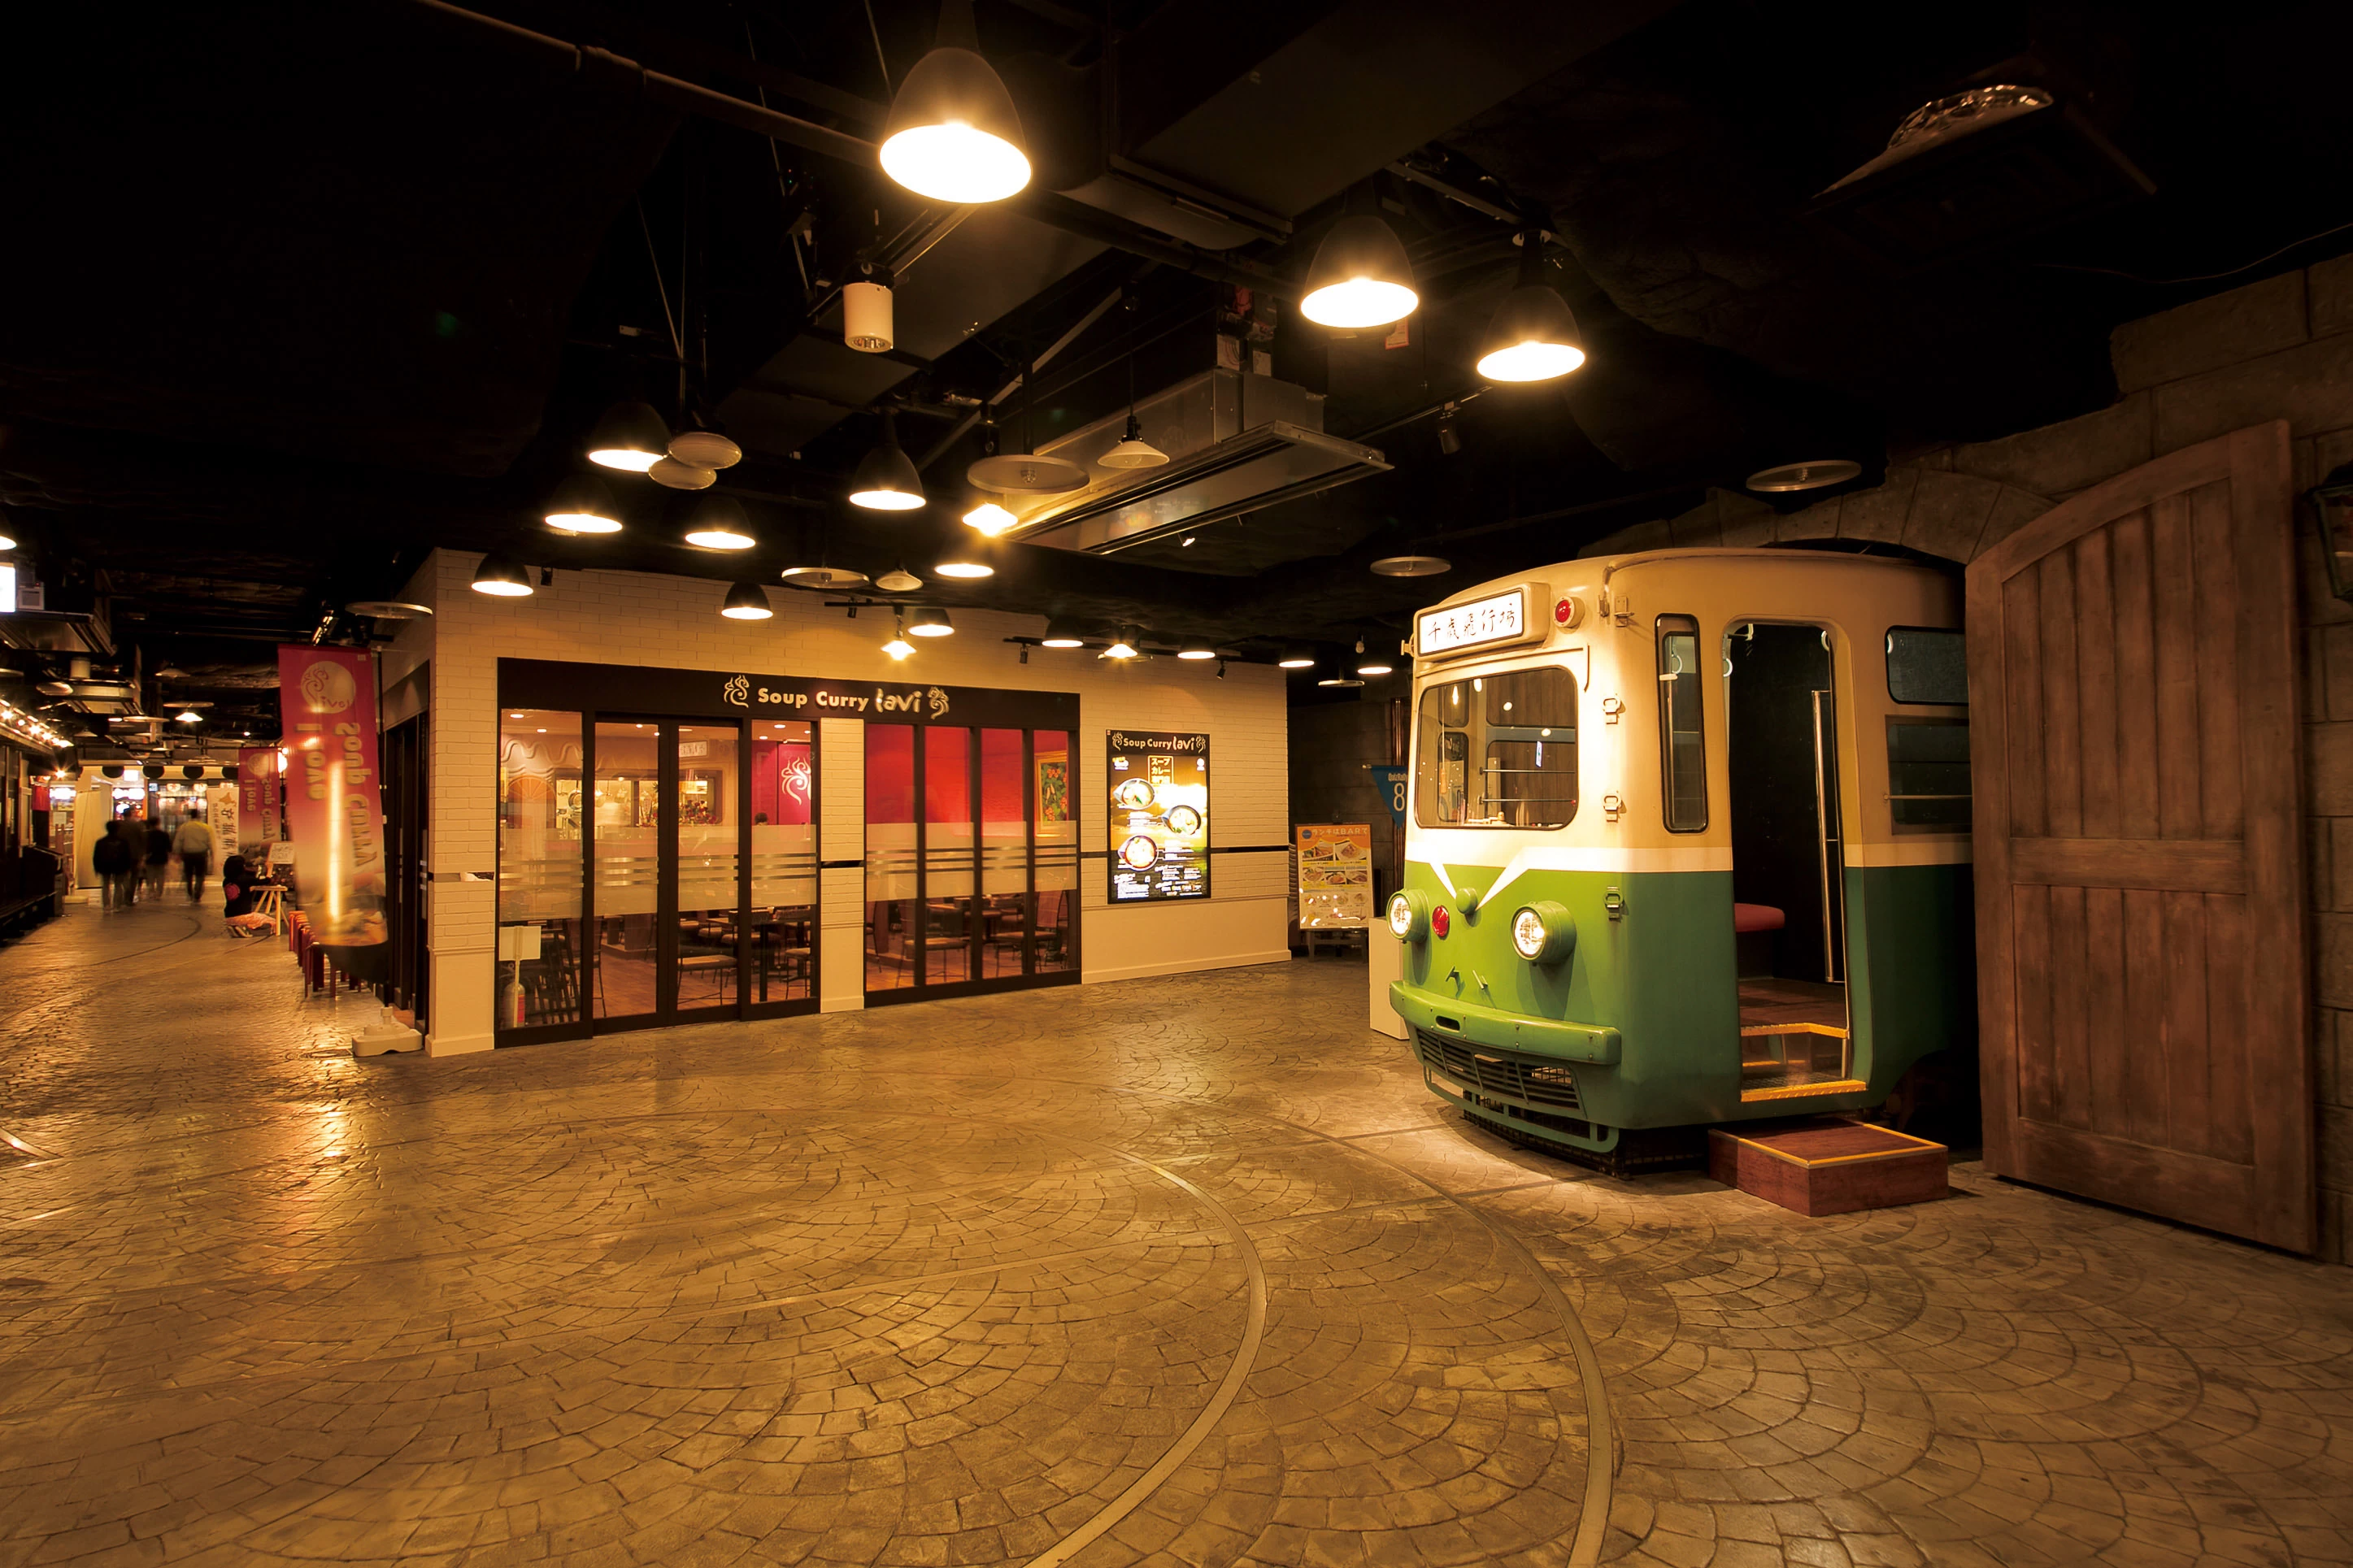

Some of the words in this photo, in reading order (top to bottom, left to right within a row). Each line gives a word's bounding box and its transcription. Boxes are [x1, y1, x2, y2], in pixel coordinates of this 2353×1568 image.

[1427, 602, 1516, 644] 千歳飛行場
[758, 688, 808, 709] Soup
[816, 691, 869, 712] Curry
[875, 688, 923, 713] lavi
[1123, 738, 1146, 749] Soup
[1146, 738, 1172, 750] Curry
[1172, 736, 1195, 750] lavi
[1151, 758, 1171, 766] スープ
[1151, 767, 1171, 775] カレー
[1393, 782, 1405, 812] 8
